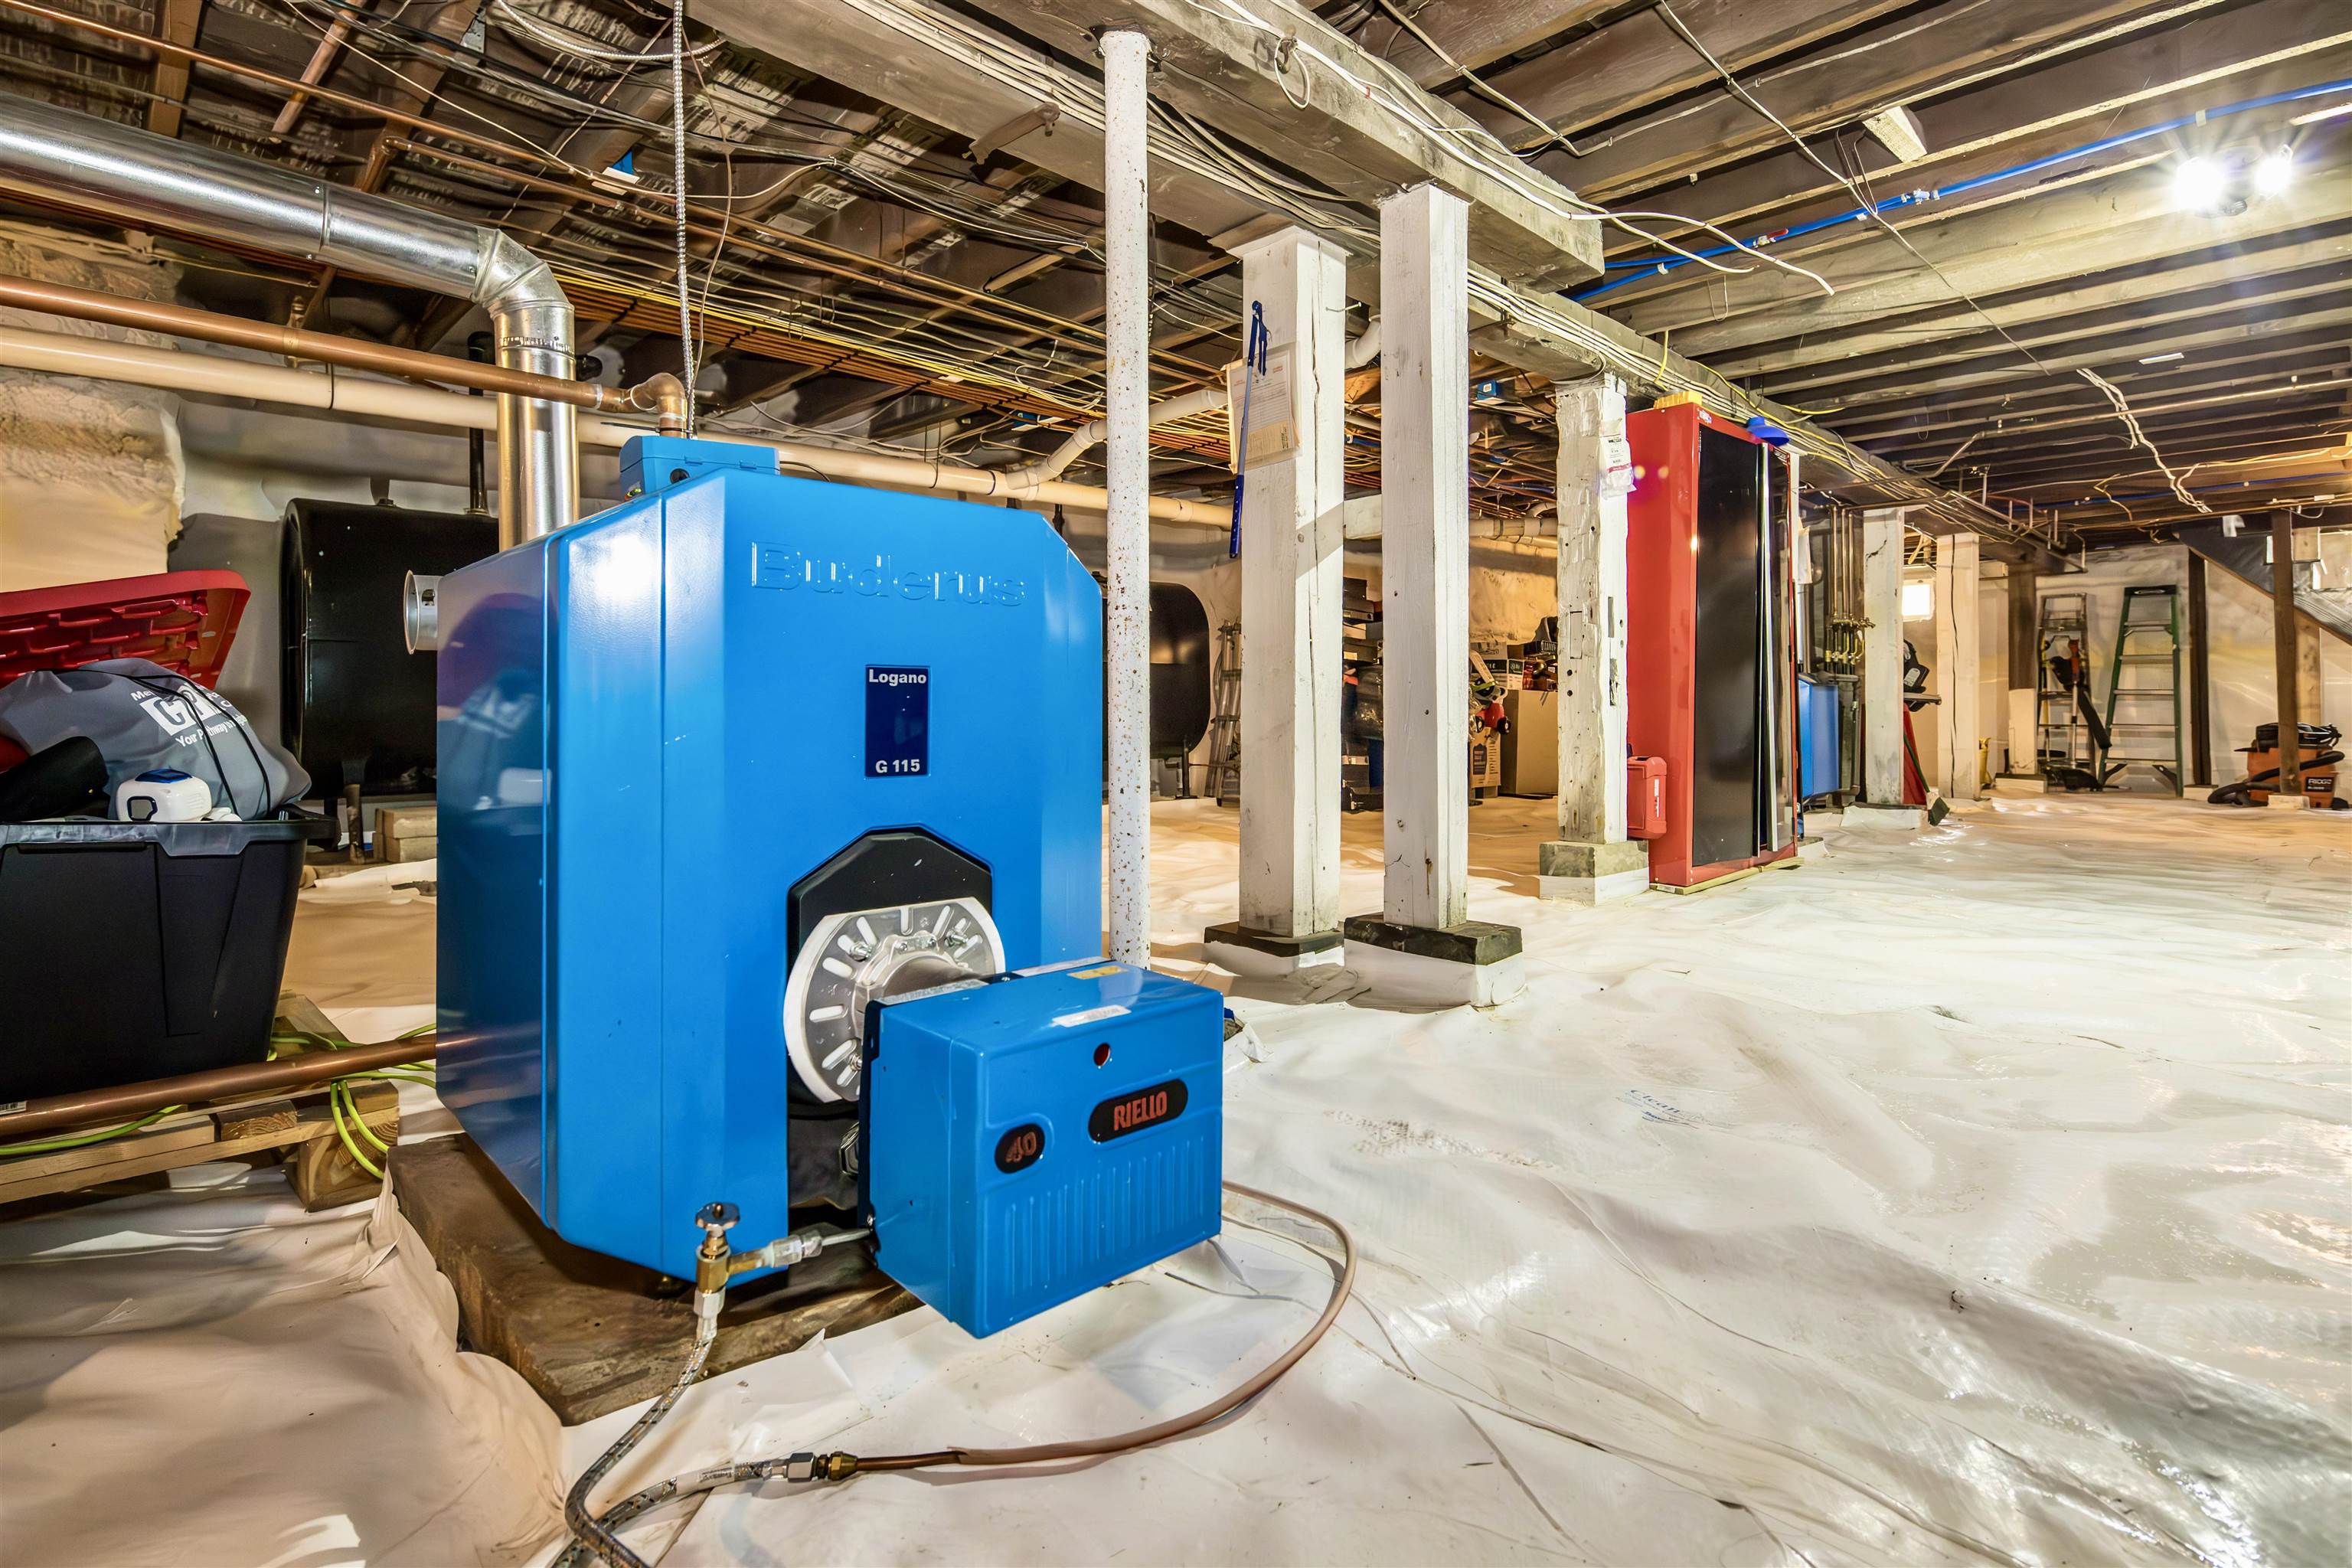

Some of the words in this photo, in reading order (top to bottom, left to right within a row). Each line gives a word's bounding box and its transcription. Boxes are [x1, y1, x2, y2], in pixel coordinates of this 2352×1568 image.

[751, 541, 1027, 607] Buderus
[869, 668, 927, 687] Logano
[175, 733, 198, 748] Your
[197, 721, 229, 740] Pthway
[875, 760, 888, 773] G
[893, 759, 920, 773] 115
[1113, 1090, 1168, 1132] RIELLO
[1004, 1132, 1037, 1164] 40
